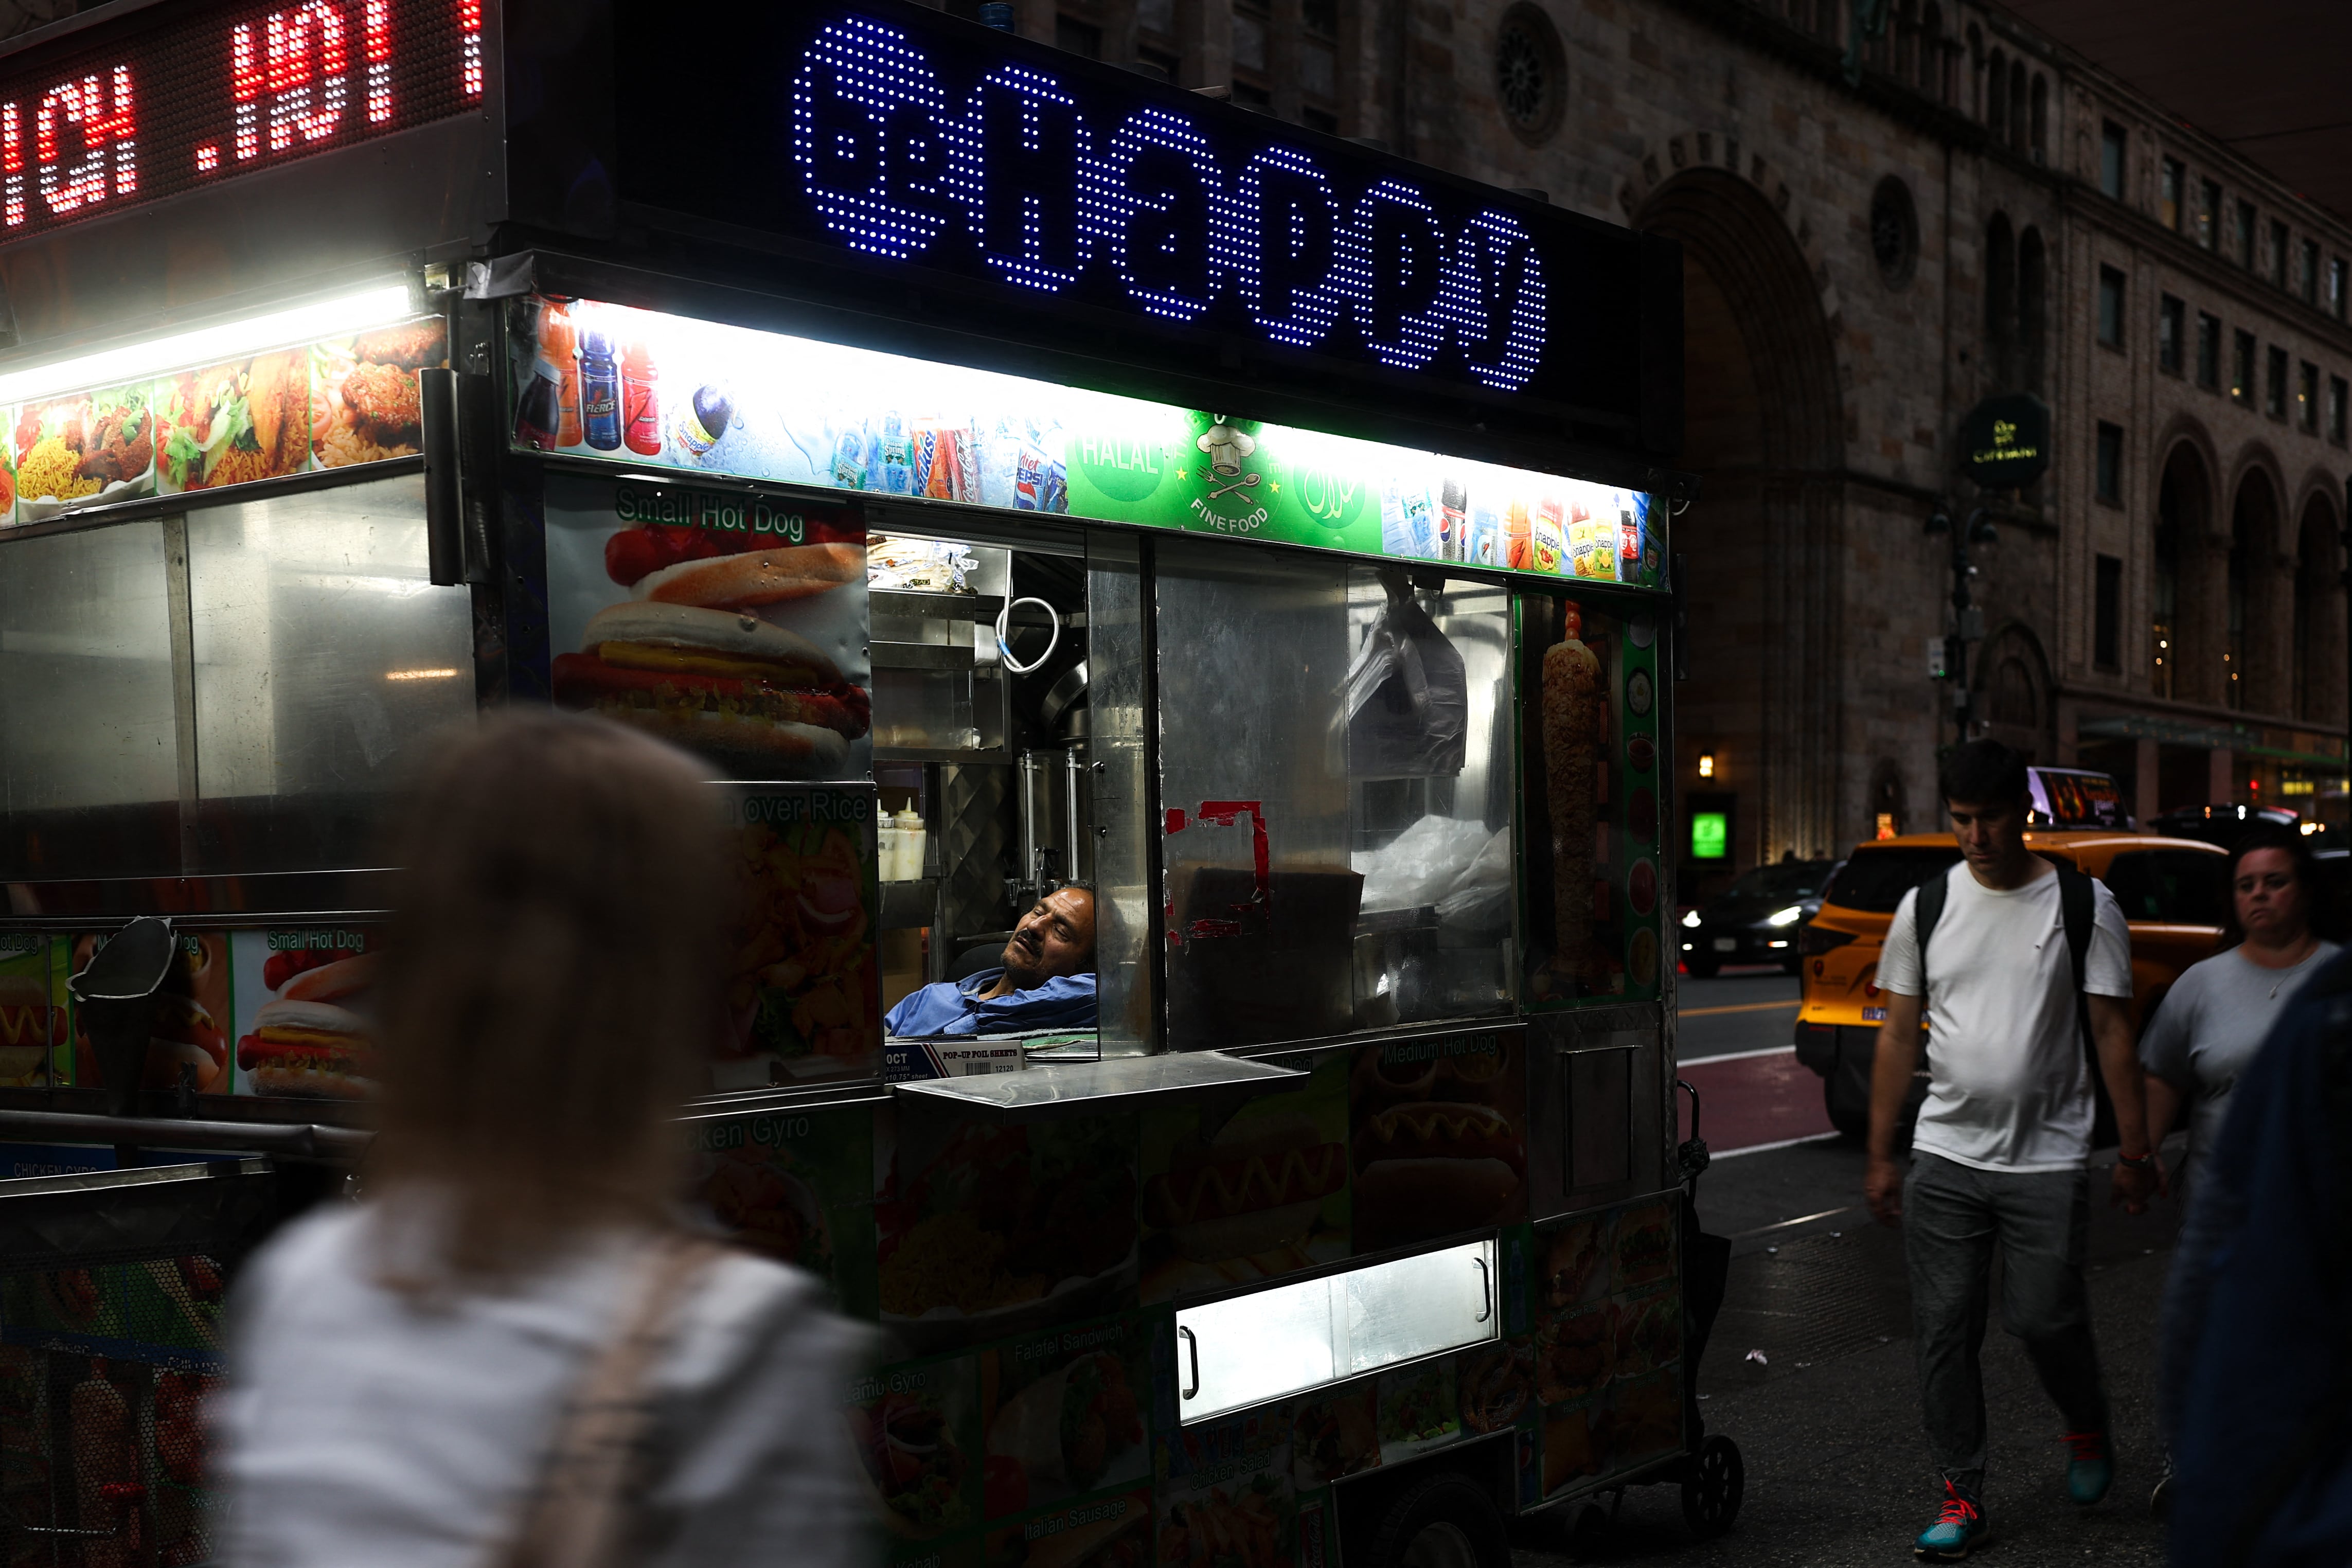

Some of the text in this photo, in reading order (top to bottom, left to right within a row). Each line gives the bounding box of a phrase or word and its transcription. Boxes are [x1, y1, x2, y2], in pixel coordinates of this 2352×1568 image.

[586, 402, 616, 414] FIERCE
[679, 420, 709, 451] Snapple
[884, 446, 905, 457] Spring
[1019, 451, 1042, 472] diet
[1082, 434, 1159, 474] HALAL
[838, 462, 858, 484] Spring
[617, 487, 805, 543] Small Hot Dog
[1190, 497, 1269, 532] FINE FOOD
[1535, 526, 1560, 551] Snapple
[1572, 542, 1594, 559] Snapple
[1595, 536, 1614, 551] Snapple
[744, 796, 804, 822] over
[811, 791, 868, 821] Rice
[0, 934, 38, 955] ot Dog
[268, 930, 364, 953] Small Hot Dog
[990, 1049, 1018, 1058] SHEETS
[1384, 1033, 1497, 1064] Medium Hot Dog
[683, 1115, 810, 1151] cken Gyro
[14, 1162, 62, 1178] CHICKEN
[1569, 1308, 1582, 1320] over
[1583, 1304, 1597, 1314] Rice
[1014, 1322, 1124, 1363] Falafel Sandwich
[889, 1369, 926, 1398] Gyro
[1563, 1402, 1575, 1414] Hot
[1190, 1450, 1271, 1491] Chicken Salad
[1024, 1499, 1127, 1541] Italian Sausage
